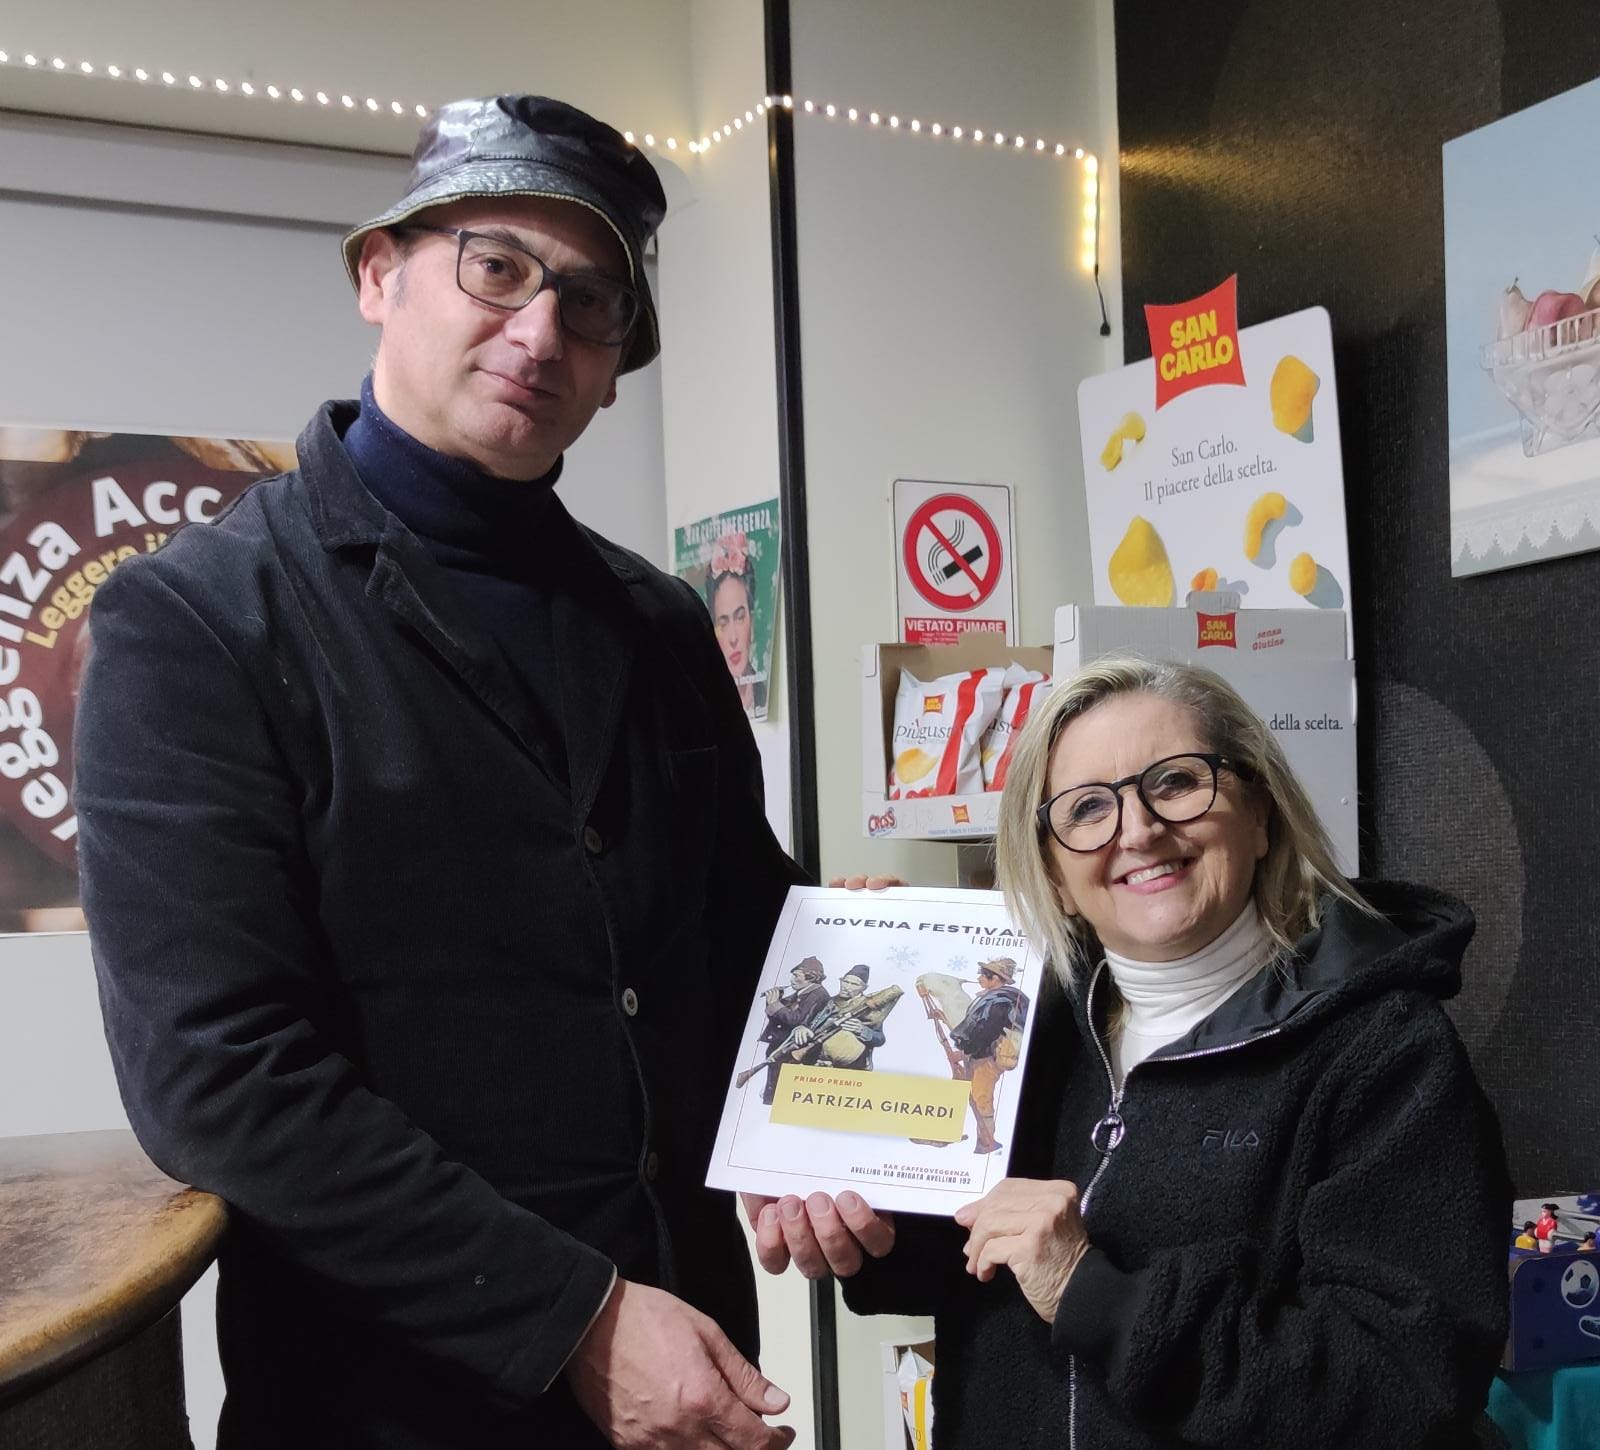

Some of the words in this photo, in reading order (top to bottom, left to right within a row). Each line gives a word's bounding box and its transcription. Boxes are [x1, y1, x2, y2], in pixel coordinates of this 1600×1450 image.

[1170, 309, 1218, 350] SAN
[1160, 335, 1234, 381] CARLO
[1171, 447, 1194, 467] San
[1198, 433, 1238, 460] Carlo.
[1144, 480, 1153, 501] Il
[1157, 477, 1200, 504] piacere
[1203, 462, 1234, 487] della
[1237, 454, 1277, 480] scelta.
[906, 620, 954, 632] VIETATO
[957, 621, 1003, 633] FUMARE
[1206, 620, 1227, 631] SAN
[1200, 630, 1233, 641] CARLO
[1269, 713, 1301, 731] della
[1304, 712, 1344, 731] scelta.
[815, 917, 912, 930] NOVENA
[918, 922, 1028, 938] FESTIVAL
[979, 936, 1025, 948] EDIZIONE
[793, 1075, 824, 1084] PRIMO
[827, 1078, 863, 1088] PREMIO
[791, 1091, 873, 1111] PATRIZIA
[880, 1100, 954, 1119] GIRARDI
[1202, 1129, 1260, 1149] FILA
[850, 1166, 881, 1176] AVELLINO
[883, 1169, 894, 1177] VIA
[896, 1171, 924, 1180] BRIGATA
[926, 1174, 957, 1184] AVELLINO
